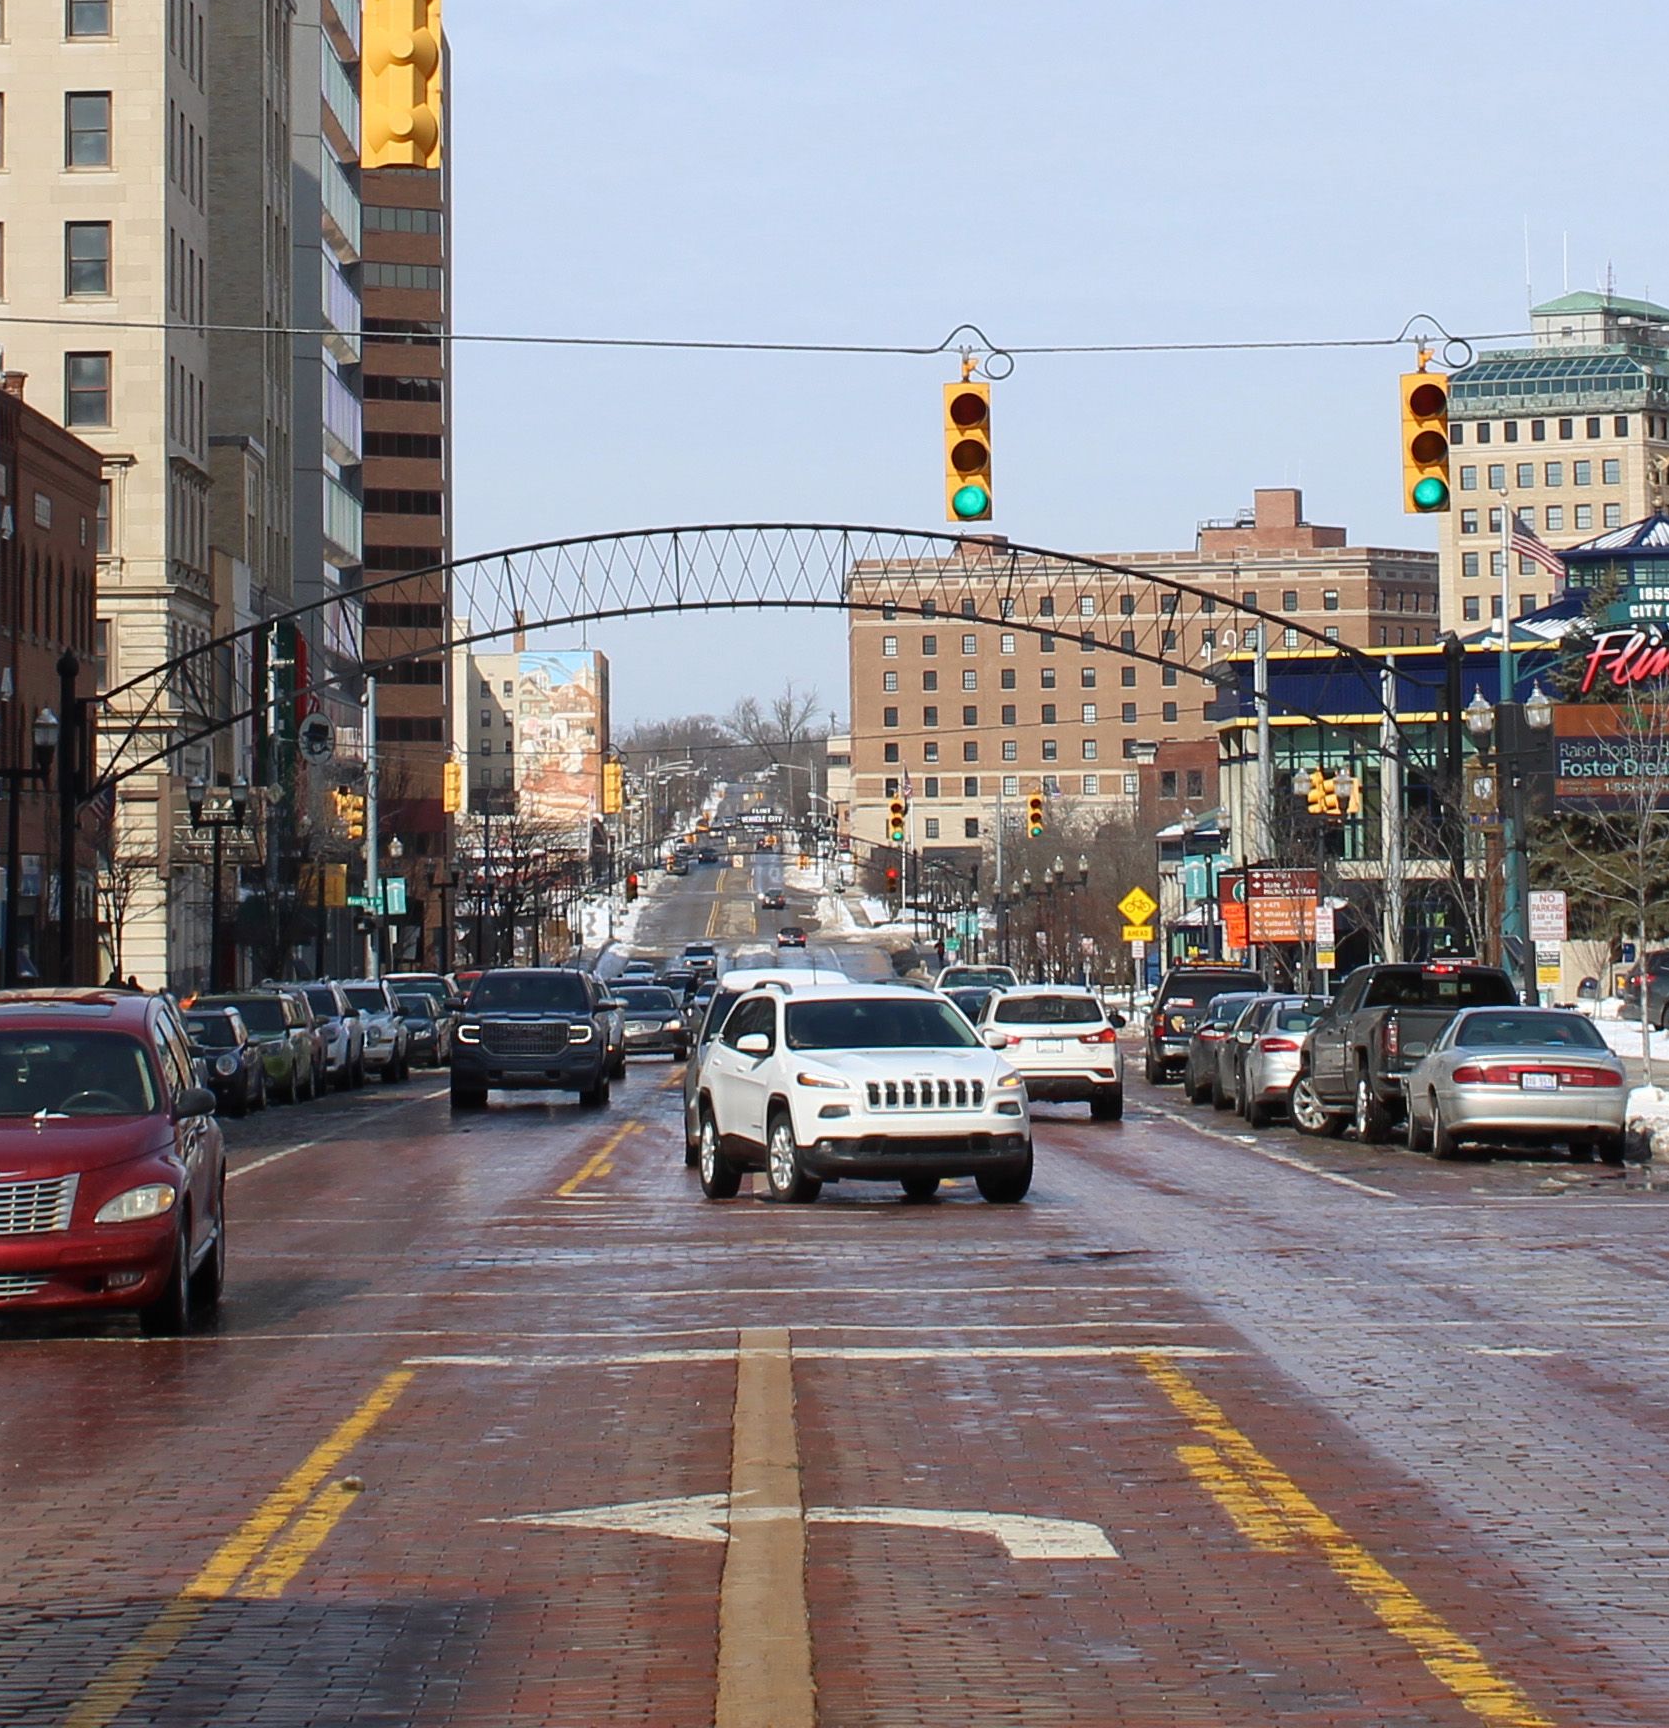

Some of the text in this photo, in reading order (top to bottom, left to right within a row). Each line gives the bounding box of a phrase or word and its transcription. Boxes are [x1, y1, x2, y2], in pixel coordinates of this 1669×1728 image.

[1629, 604, 1661, 618] CITY
[1560, 742, 1596, 758] Raise
[1560, 759, 1620, 777] Foster
[182, 845, 244, 856] STRET
[1539, 894, 1556, 904] NO
[1531, 903, 1564, 912] PARKING
